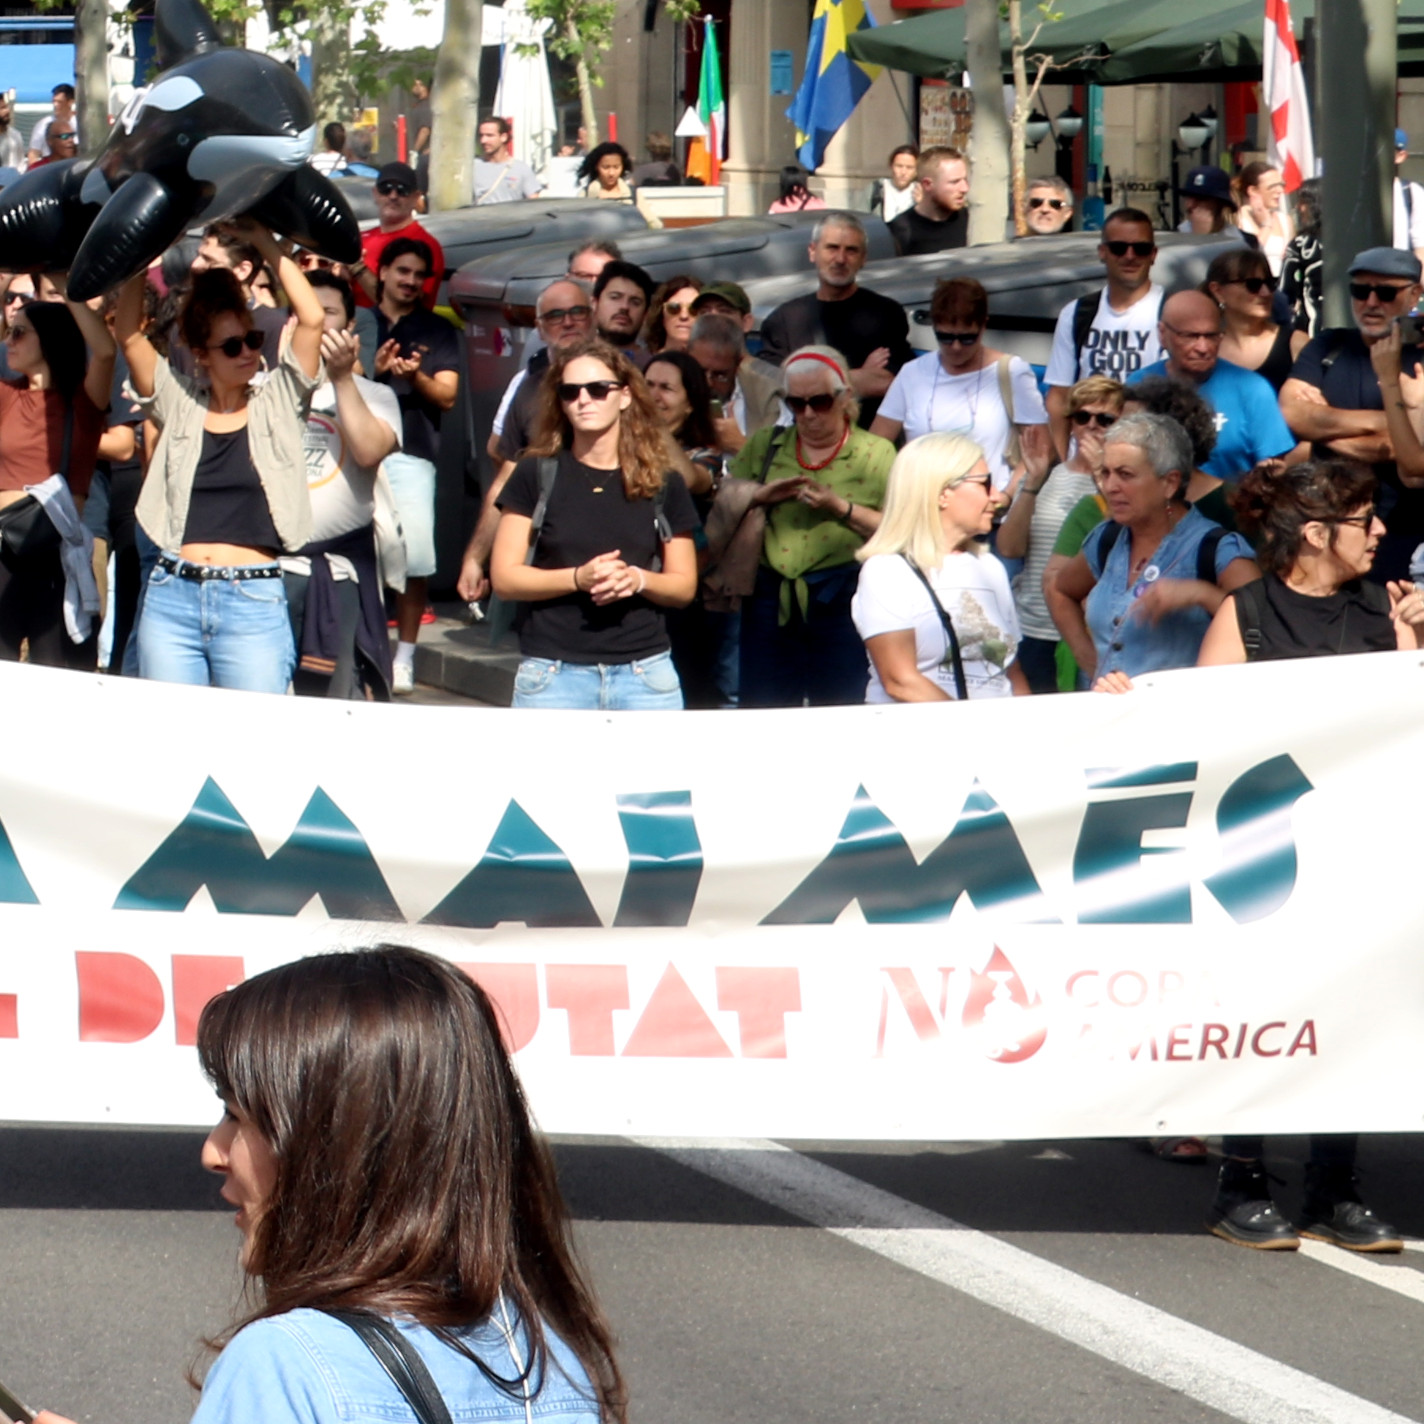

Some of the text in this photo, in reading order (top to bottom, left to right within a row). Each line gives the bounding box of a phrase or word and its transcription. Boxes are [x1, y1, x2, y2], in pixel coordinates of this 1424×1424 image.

[1084, 328, 1150, 351] ONLY
[1089, 349, 1141, 372] GOD
[872, 942, 1049, 1064] NO
